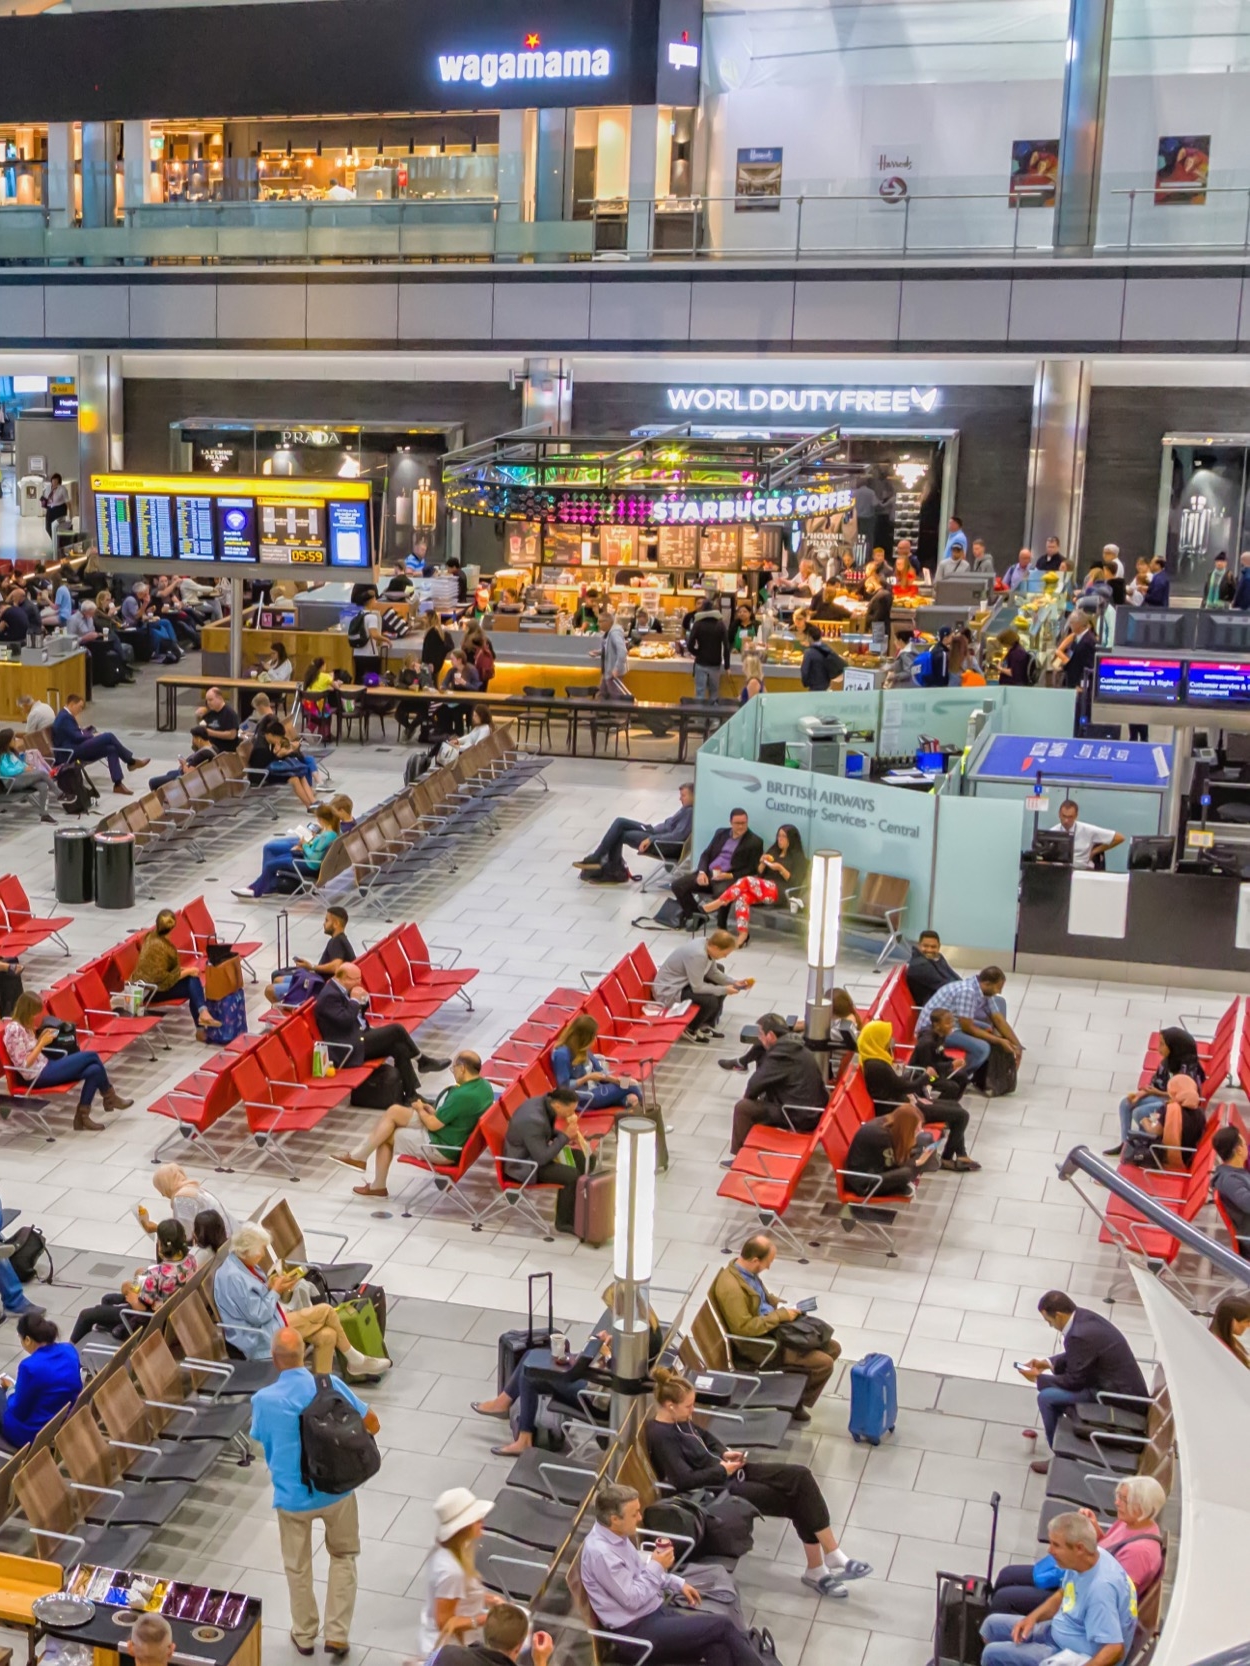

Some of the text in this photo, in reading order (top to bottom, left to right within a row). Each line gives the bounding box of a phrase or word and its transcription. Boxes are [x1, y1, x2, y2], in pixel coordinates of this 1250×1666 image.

[439, 49, 610, 87] wagamama
[878, 154, 912, 171] Harrods
[281, 431, 340, 445] PRADA
[653, 489, 853, 521] STARBUCKS COFFEE
[292, 550, 323, 562] 05:59
[1100, 677, 1129, 685] Customer
[1129, 678, 1150, 686] service
[1100, 684, 1140, 693] management
[1189, 681, 1218, 689] Customer
[1219, 683, 1240, 691] service
[1188, 688, 1229, 697] management
[766, 780, 876, 813] BRITISH AIRWAYS
[765, 797, 818, 819] Customer
[821, 807, 867, 829] Services
[878, 818, 920, 839] Central
